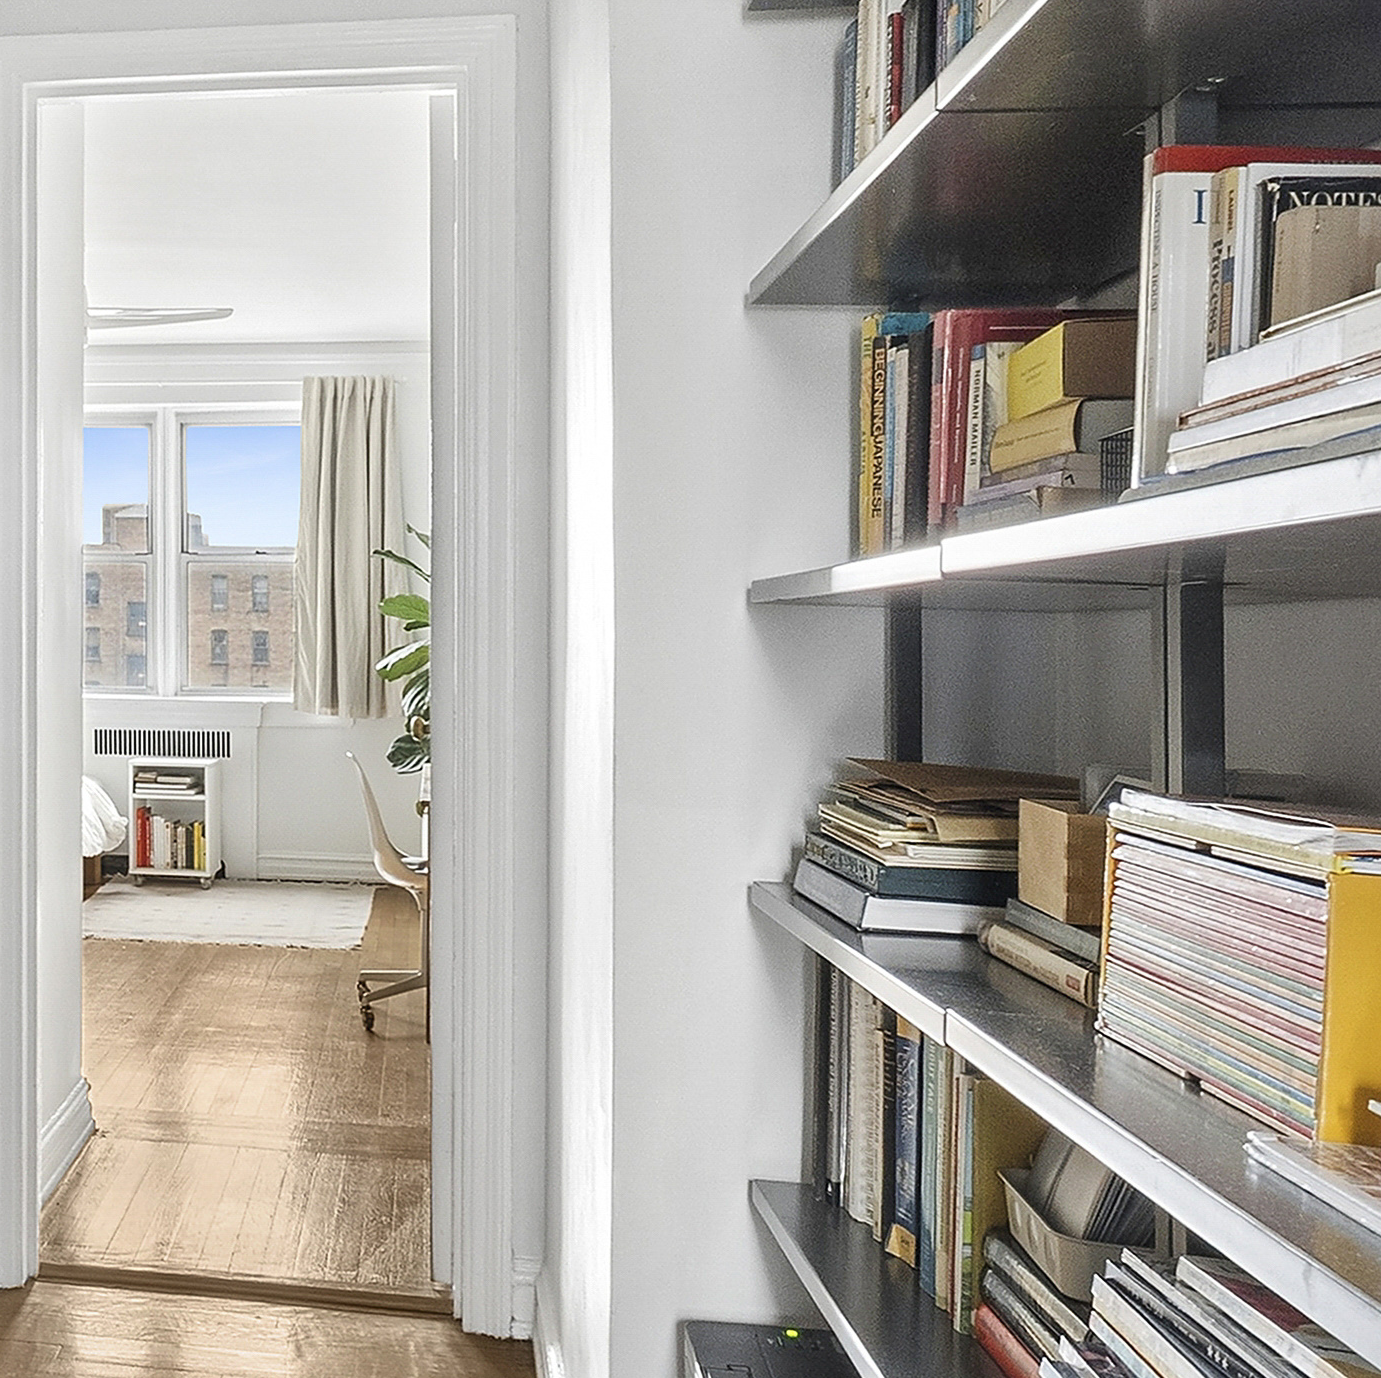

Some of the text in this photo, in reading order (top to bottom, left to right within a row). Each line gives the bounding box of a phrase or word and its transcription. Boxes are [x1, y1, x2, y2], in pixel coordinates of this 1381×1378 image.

[1151, 189, 1162, 271] INSPECTING A
[1227, 188, 1235, 235] LAUREL
[1208, 239, 1223, 333] Process
[872, 347, 886, 519] BEGINNING JAPANESE
[970, 368, 982, 467] NORMAN MAILER
[927, 1082, 936, 1115] FACE
